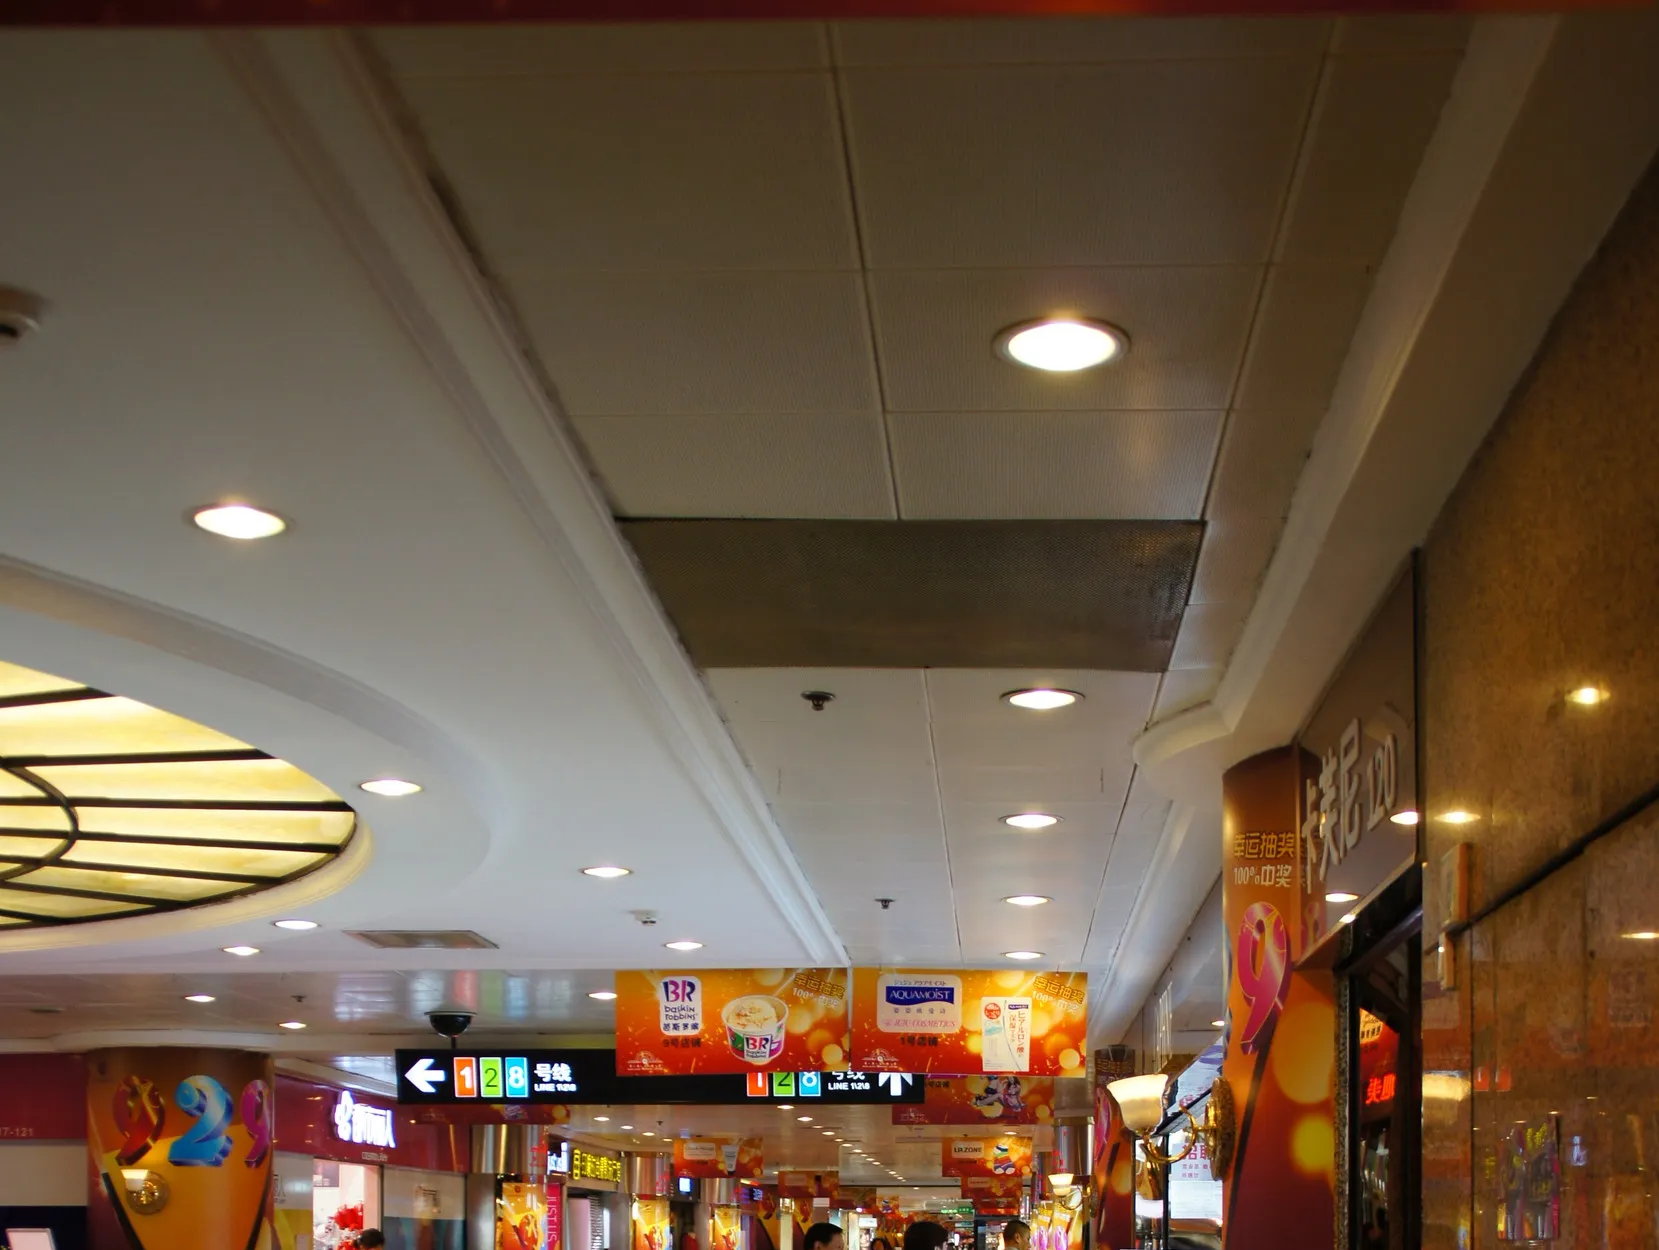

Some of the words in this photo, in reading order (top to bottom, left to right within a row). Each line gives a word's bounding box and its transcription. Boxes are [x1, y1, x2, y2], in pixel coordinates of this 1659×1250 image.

[1367, 733, 1397, 832] 120
[1233, 831, 1295, 859] 幸运抽奖
[1233, 864, 1292, 888] 100%中奖
[663, 980, 696, 1003] BR
[1033, 976, 1084, 1005] 幸运抽奖
[664, 1004, 695, 1013] baskin
[459, 1066, 472, 1089] 1
[484, 1068, 498, 1088] 2
[508, 1066, 525, 1088] 8
[534, 1063, 571, 1082] 号线
[828, 1082, 849, 1090] LINE
